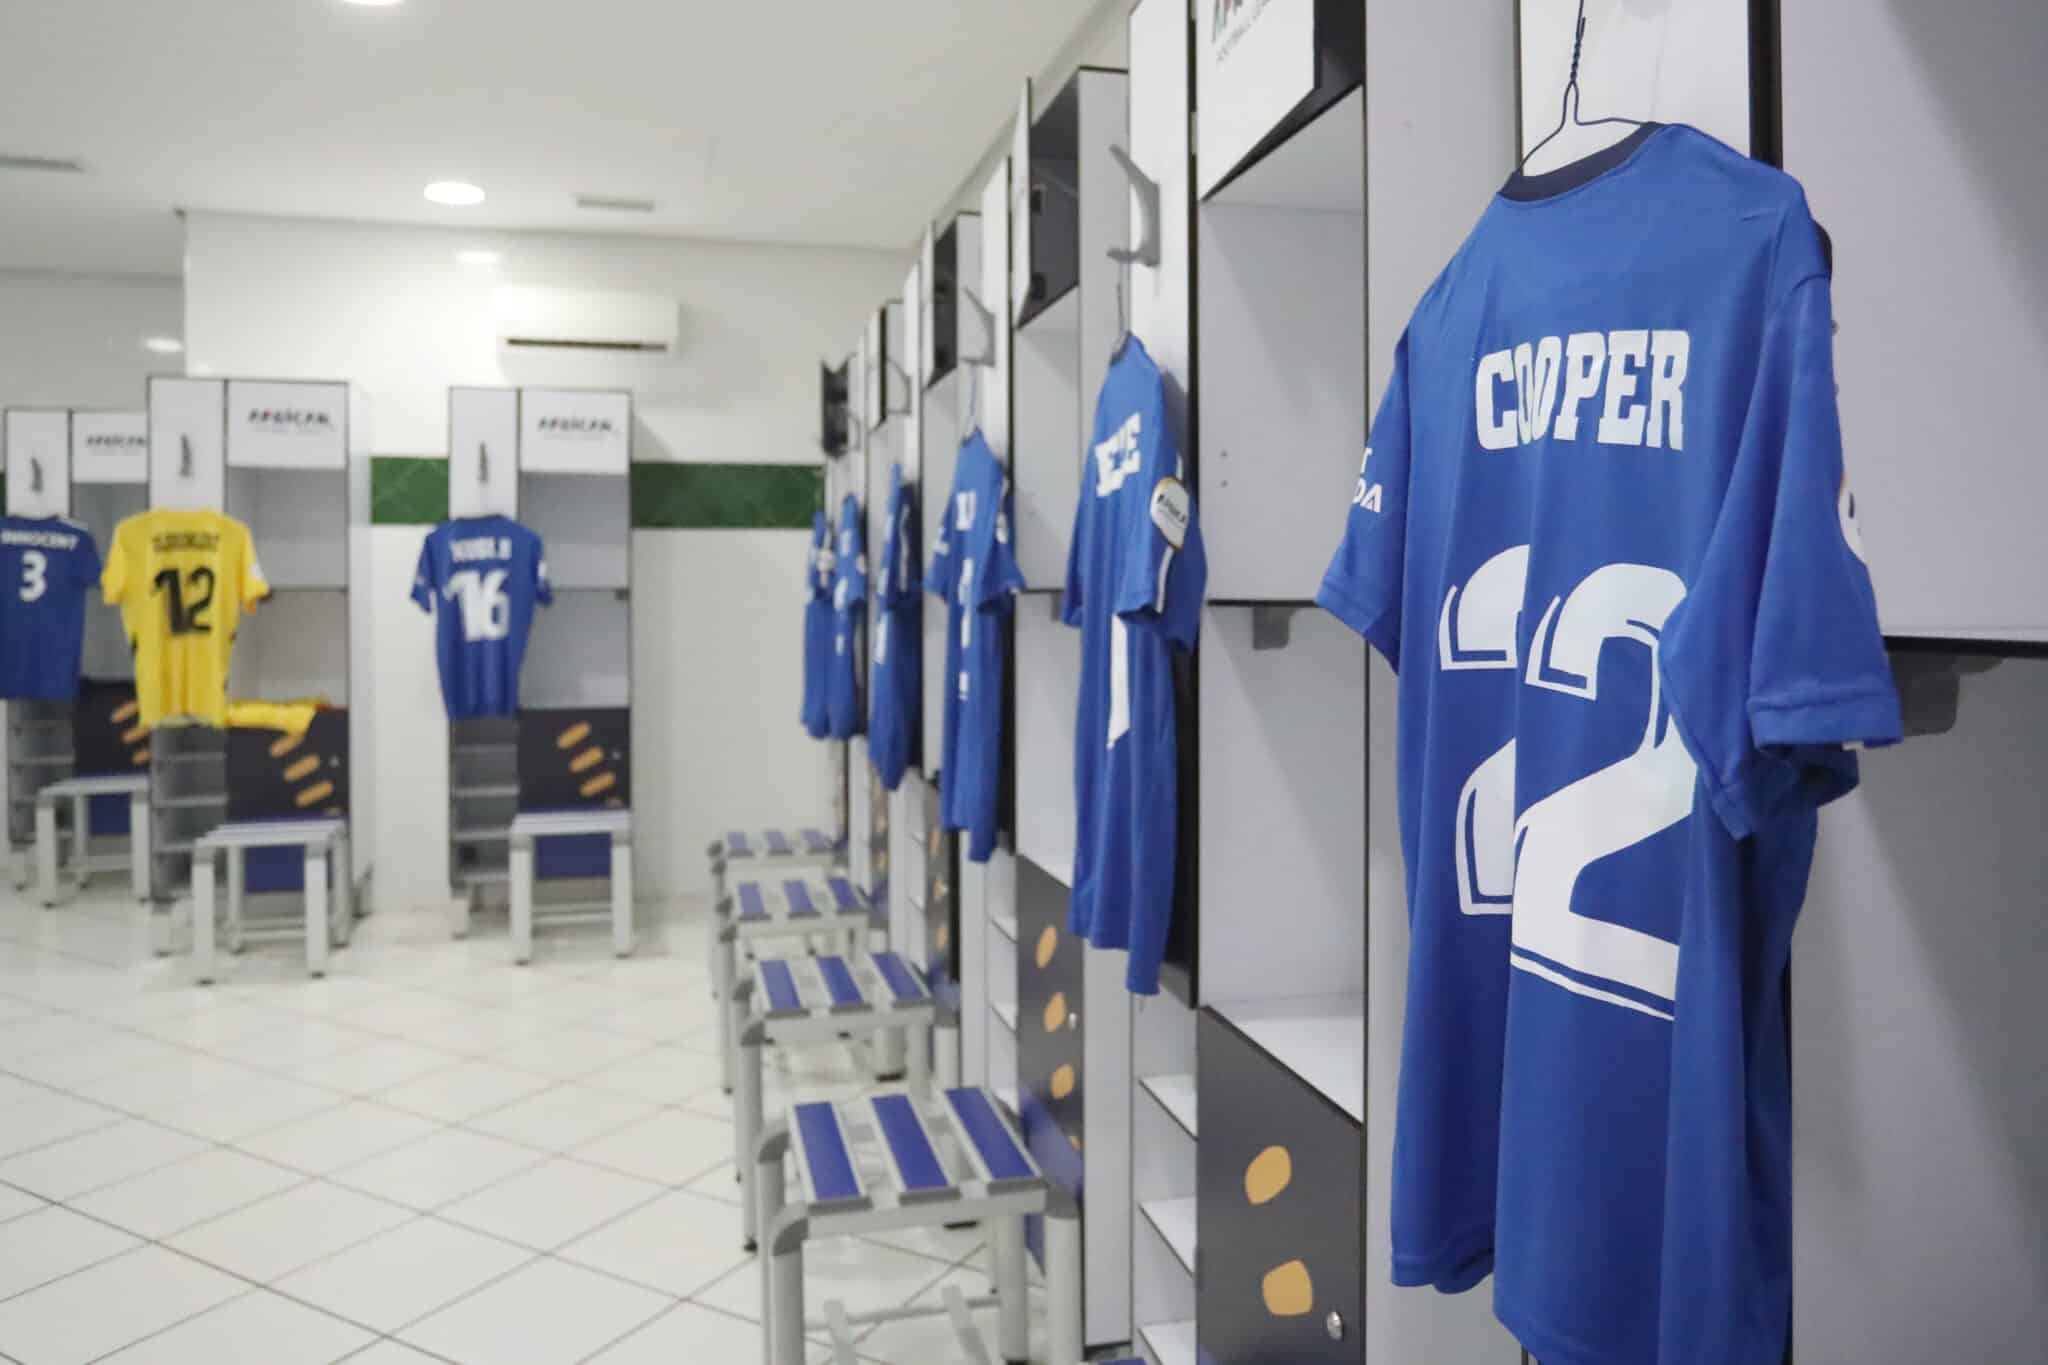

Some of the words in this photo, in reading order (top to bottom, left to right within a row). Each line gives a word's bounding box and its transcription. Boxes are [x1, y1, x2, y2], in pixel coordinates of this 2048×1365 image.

[1475, 329, 1690, 451] COOPER
[19, 550, 47, 602] 3
[152, 565, 215, 637] 12
[441, 569, 511, 642] 16
